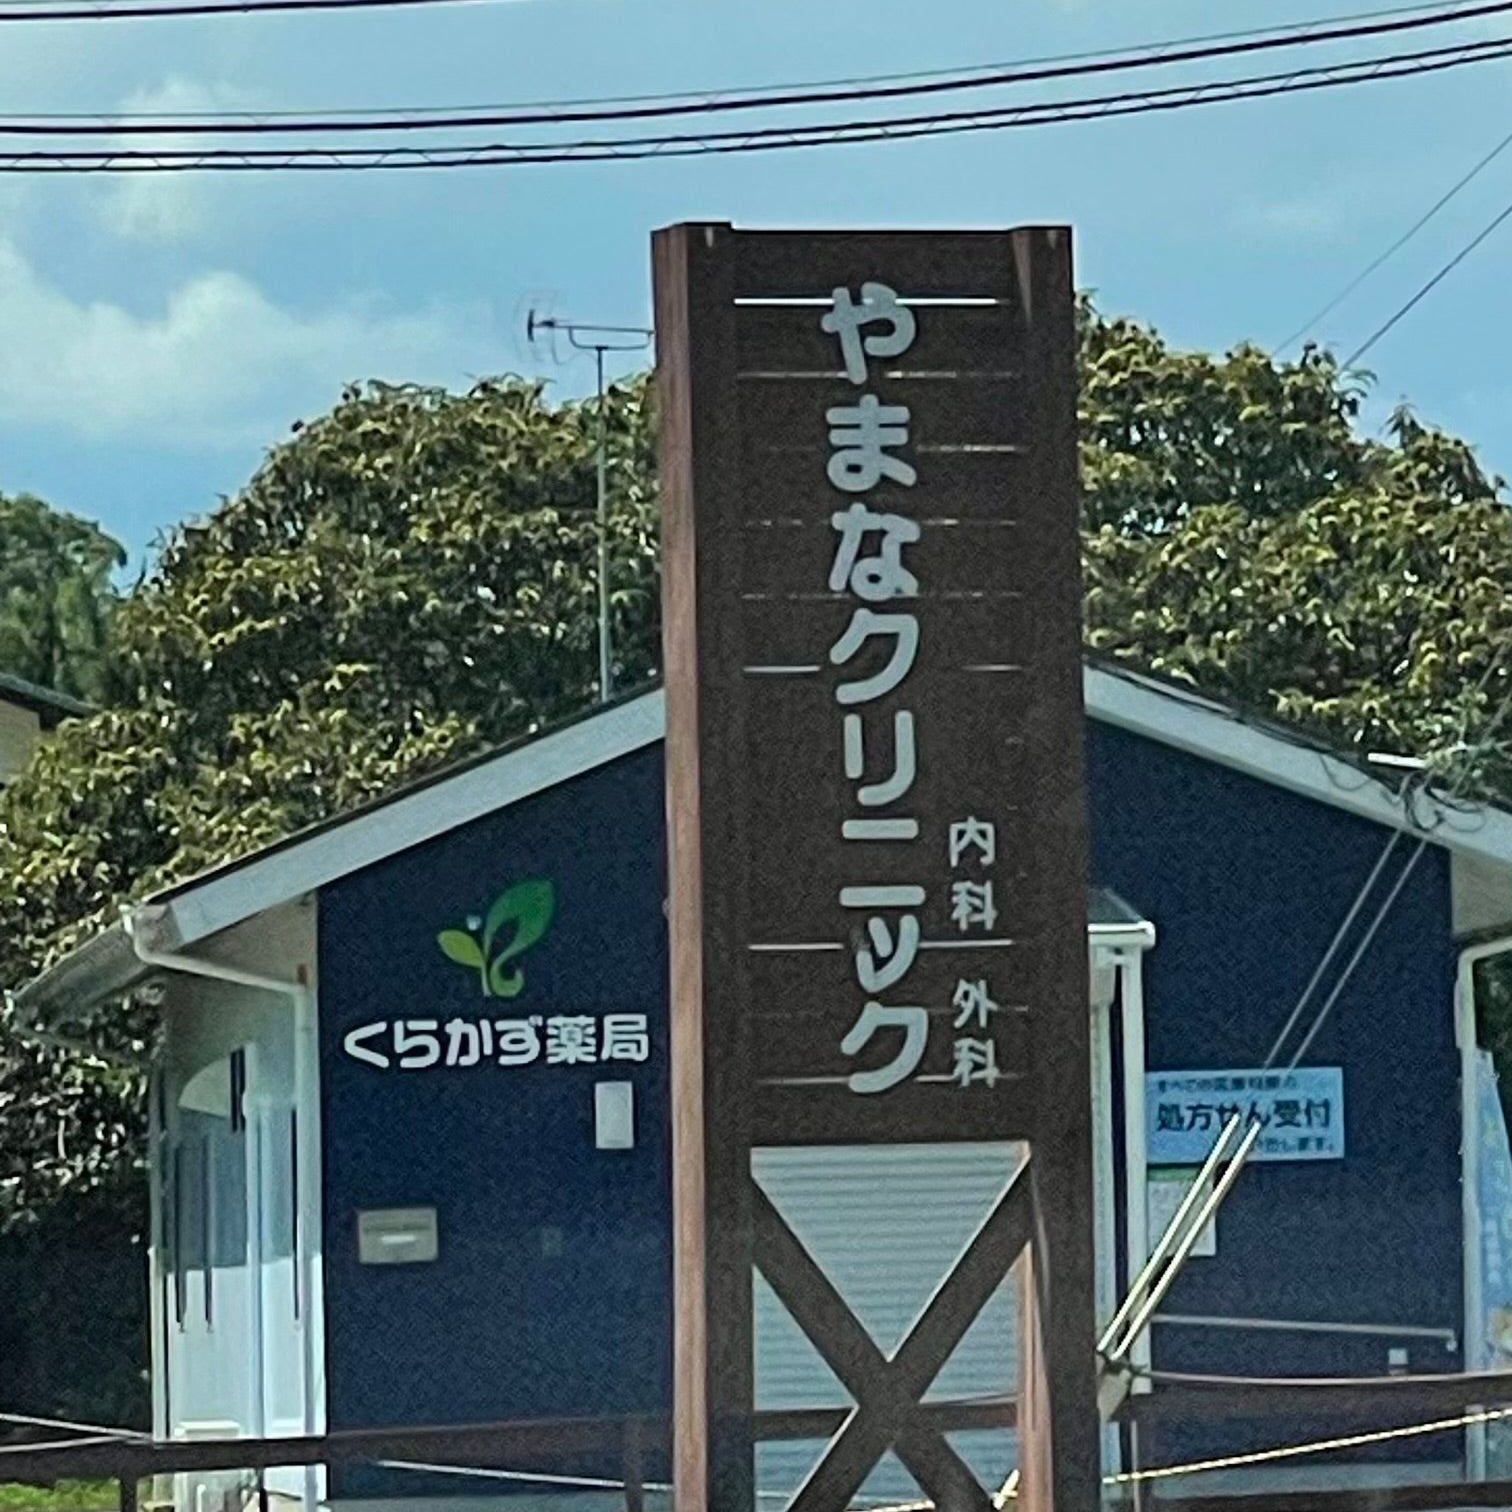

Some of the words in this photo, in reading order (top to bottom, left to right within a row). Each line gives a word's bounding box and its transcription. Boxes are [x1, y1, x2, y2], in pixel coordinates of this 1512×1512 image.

[821, 281, 928, 1093] やまなクリニック
[949, 816, 996, 931] 内科
[344, 1013, 650, 1068] くらかず薬局
[952, 978, 999, 1088] 外科
[1156, 1098, 1331, 1132] 処方せん受付
